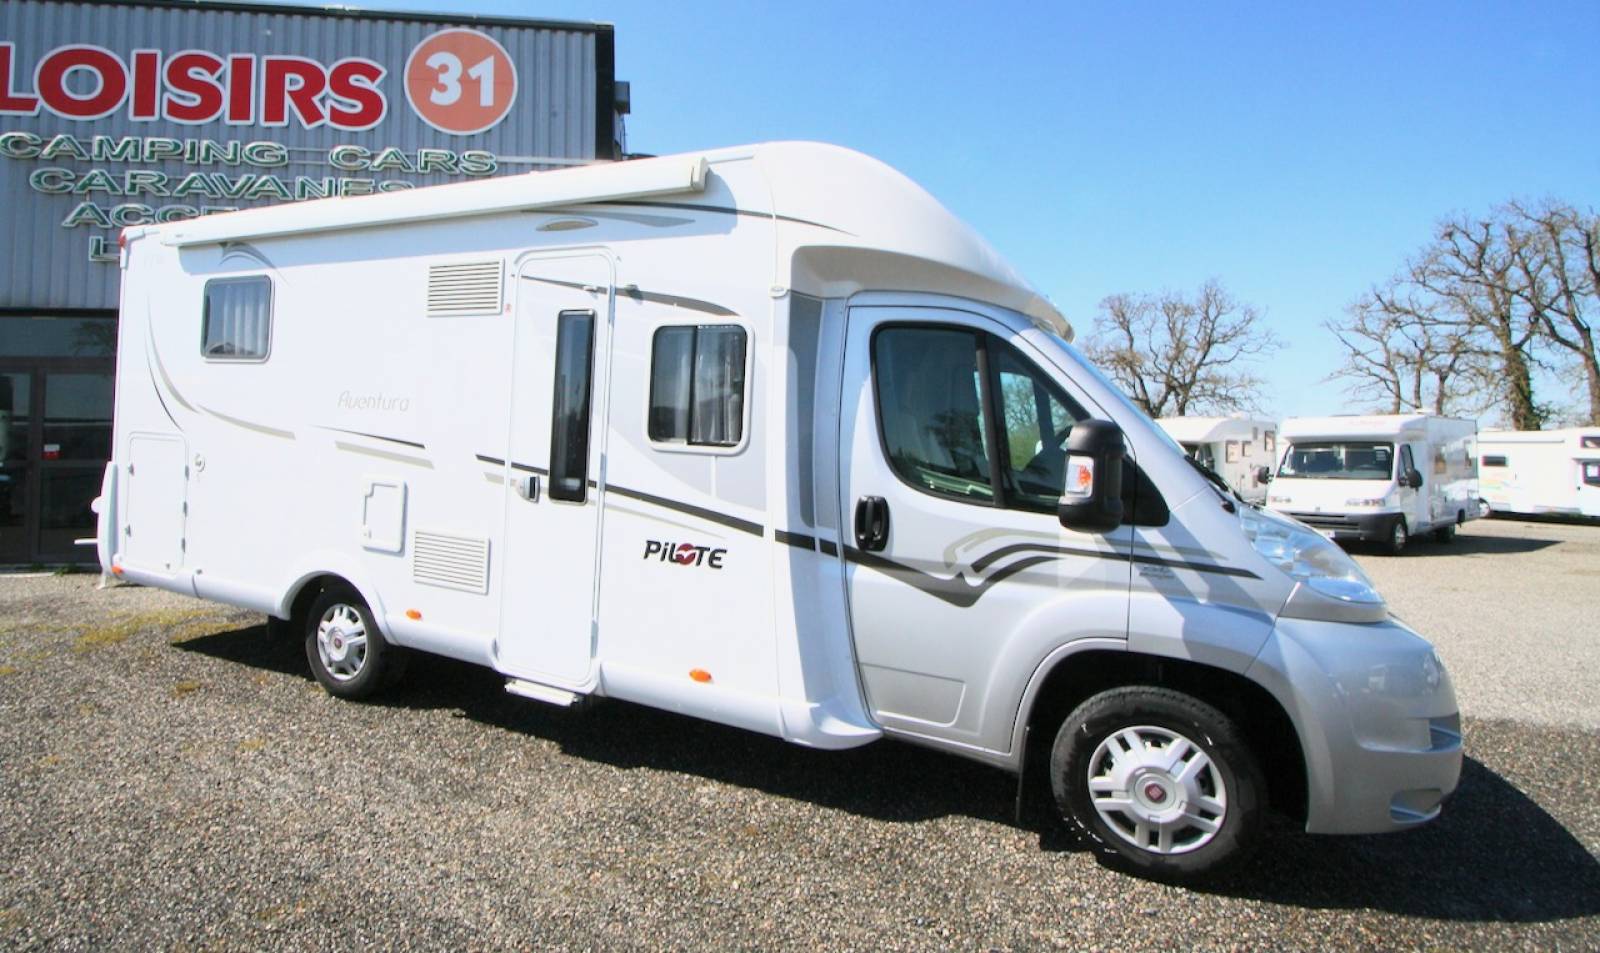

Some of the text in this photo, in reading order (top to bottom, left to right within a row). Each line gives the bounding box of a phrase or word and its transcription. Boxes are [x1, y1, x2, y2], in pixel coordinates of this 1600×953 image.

[0, 43, 496, 130] LOISIRS 31
[0, 132, 498, 175] CAMPING CARS
[337, 389, 410, 412] Aventura
